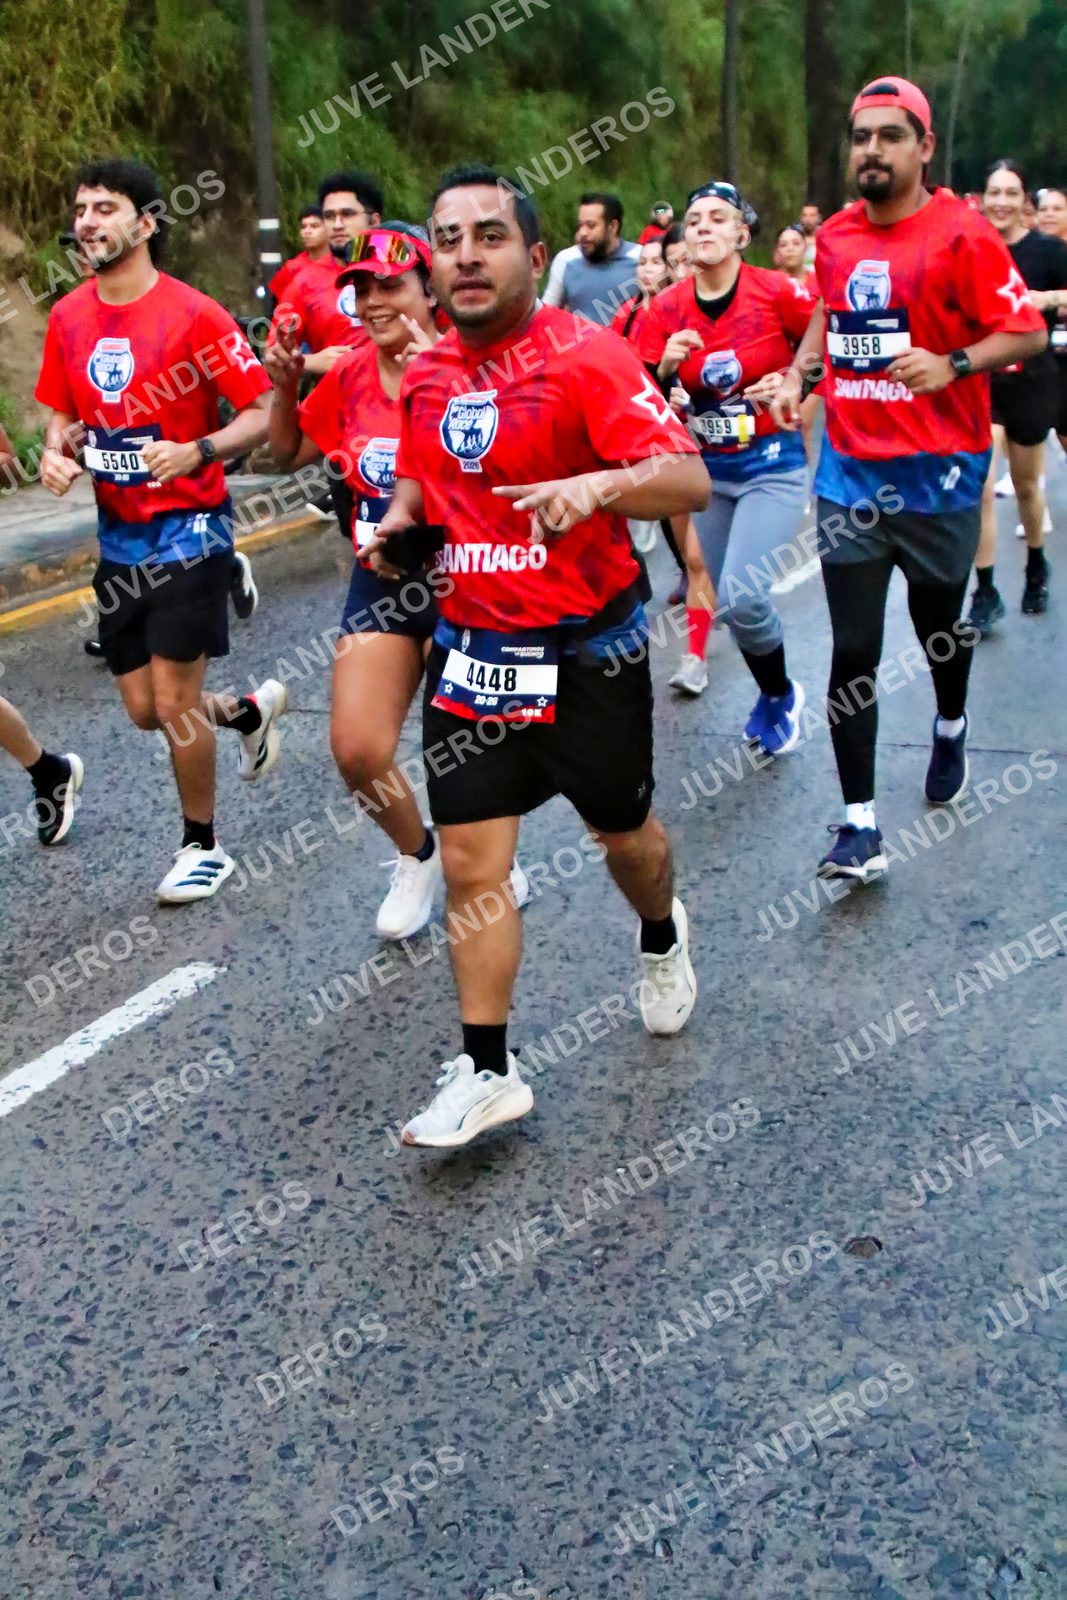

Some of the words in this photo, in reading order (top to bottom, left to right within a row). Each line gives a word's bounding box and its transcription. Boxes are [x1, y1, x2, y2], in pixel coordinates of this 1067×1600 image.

[843, 336, 881, 355] 3958
[457, 405, 487, 419] Global
[448, 418, 473, 430] Race
[700, 418, 732, 435] 3959
[101, 452, 139, 471] 5540
[466, 662, 517, 692] 4448
[521, 708, 542, 717] 10K
